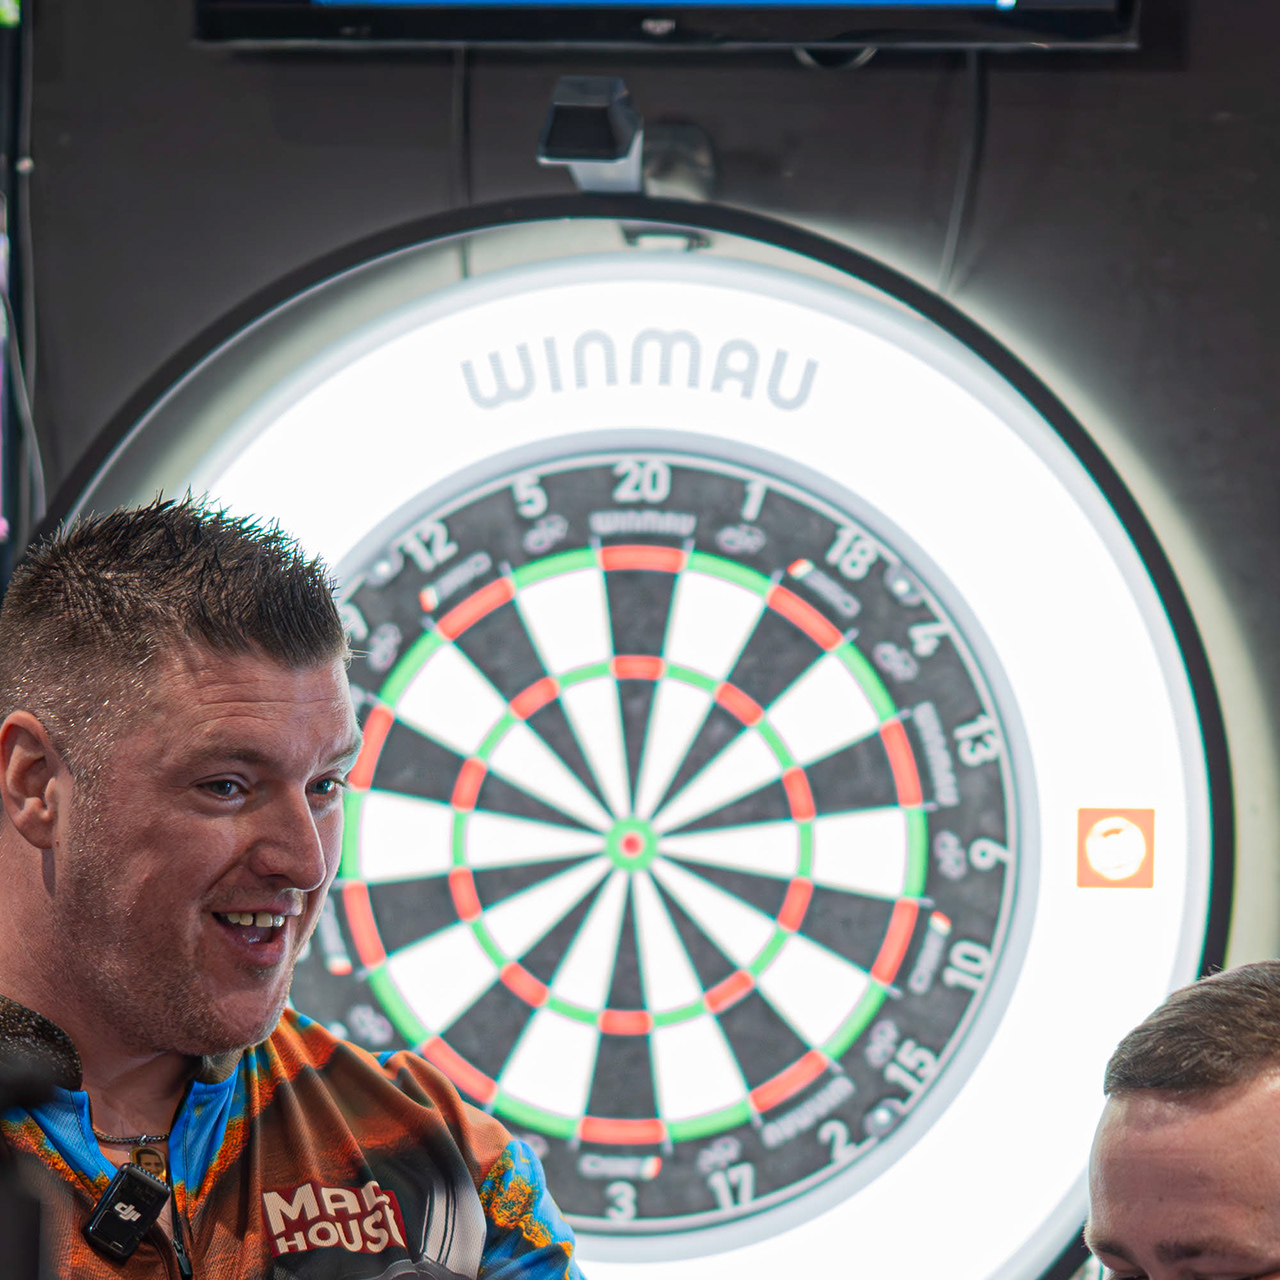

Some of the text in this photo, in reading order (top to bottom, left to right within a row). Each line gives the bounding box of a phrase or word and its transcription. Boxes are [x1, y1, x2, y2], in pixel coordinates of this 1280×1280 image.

[461, 329, 819, 411] WINMAU
[511, 472, 548, 519] 5
[611, 459, 672, 503] 20
[741, 479, 767, 522] 1
[403, 518, 460, 573] 12
[824, 525, 878, 581] 18
[908, 621, 953, 658] 4
[952, 713, 1001, 767] 13
[942, 939, 994, 997] 10
[883, 1039, 937, 1092] 15
[817, 1119, 854, 1164] 2
[604, 1180, 638, 1221] 3
[708, 1162, 756, 1210] 17
